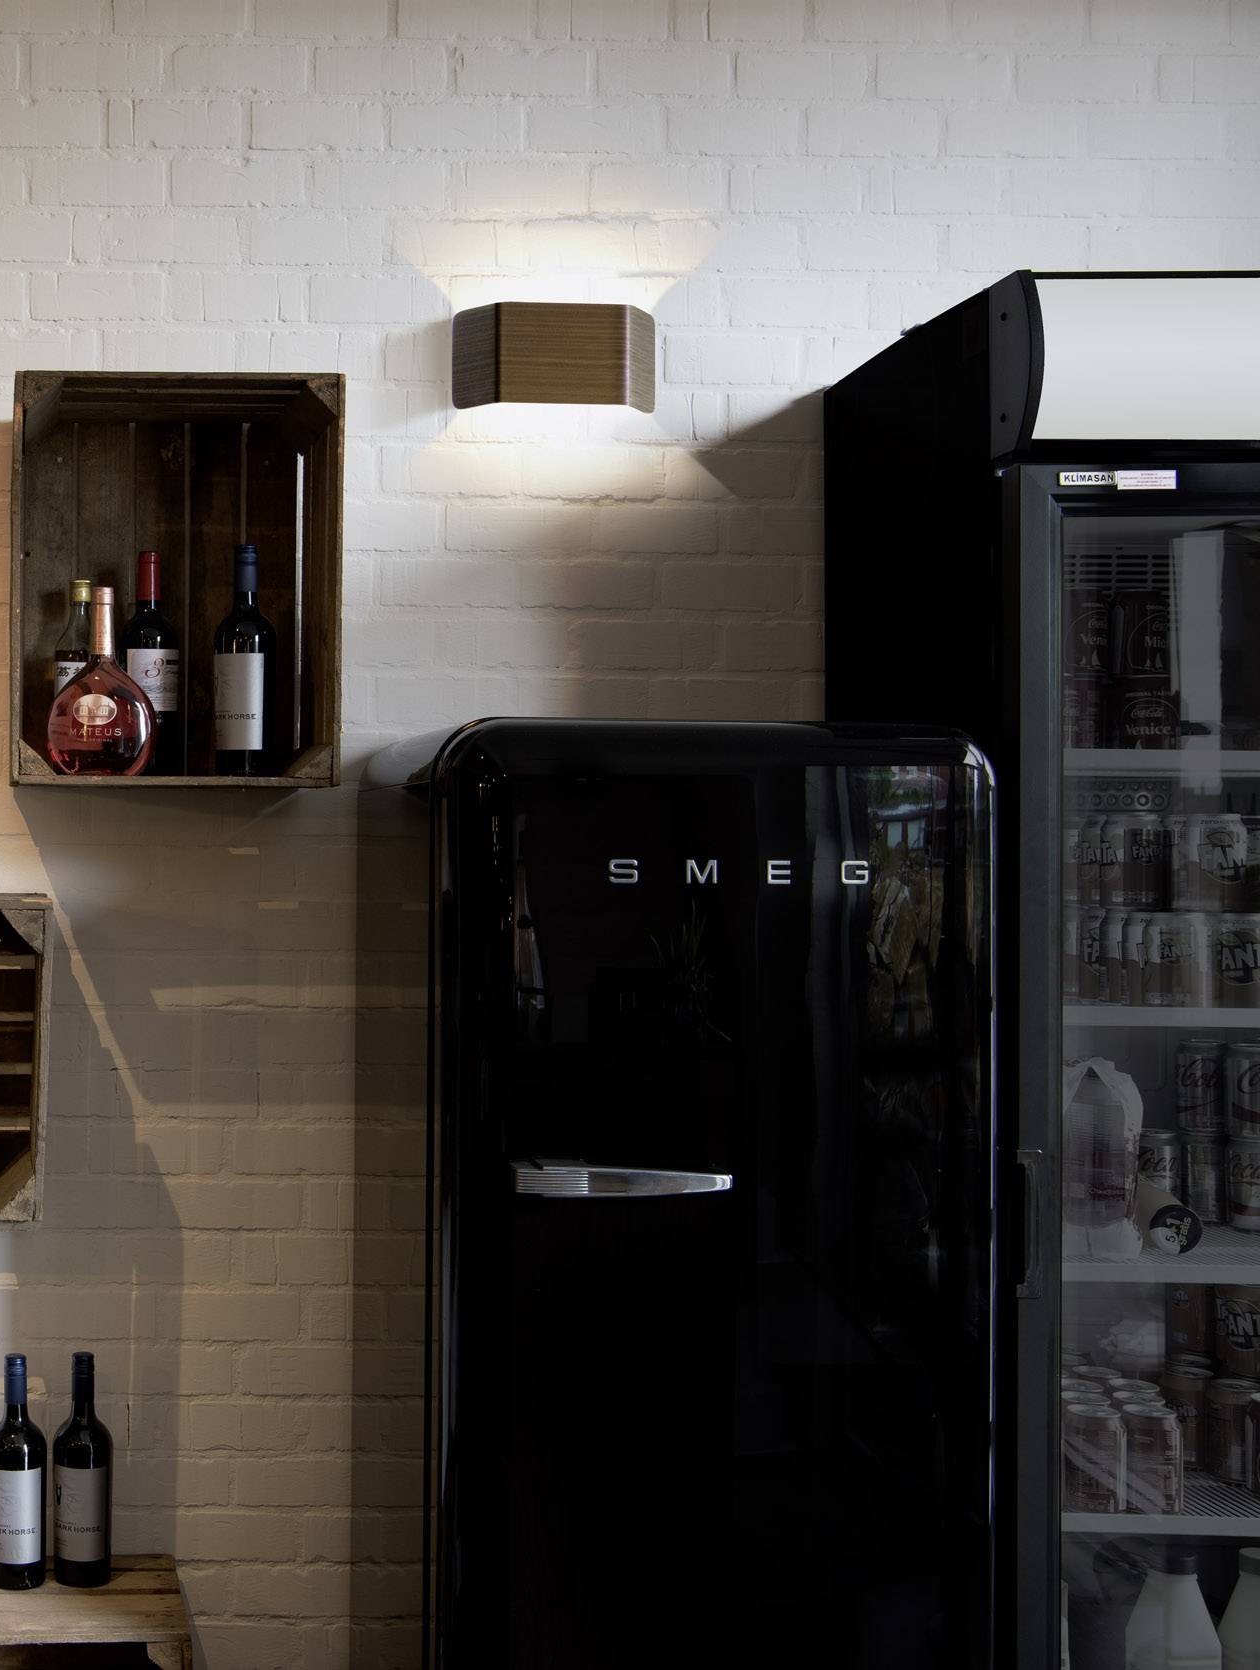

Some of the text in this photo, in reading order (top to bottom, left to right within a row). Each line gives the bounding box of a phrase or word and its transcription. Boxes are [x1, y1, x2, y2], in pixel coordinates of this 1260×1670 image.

[69, 727, 122, 737] MATEUS
[1125, 722, 1173, 735] Venice
[608, 858, 869, 885] SMEG
[8, 1527, 37, 1536] HORSE
[74, 1525, 101, 1534] HORSE
